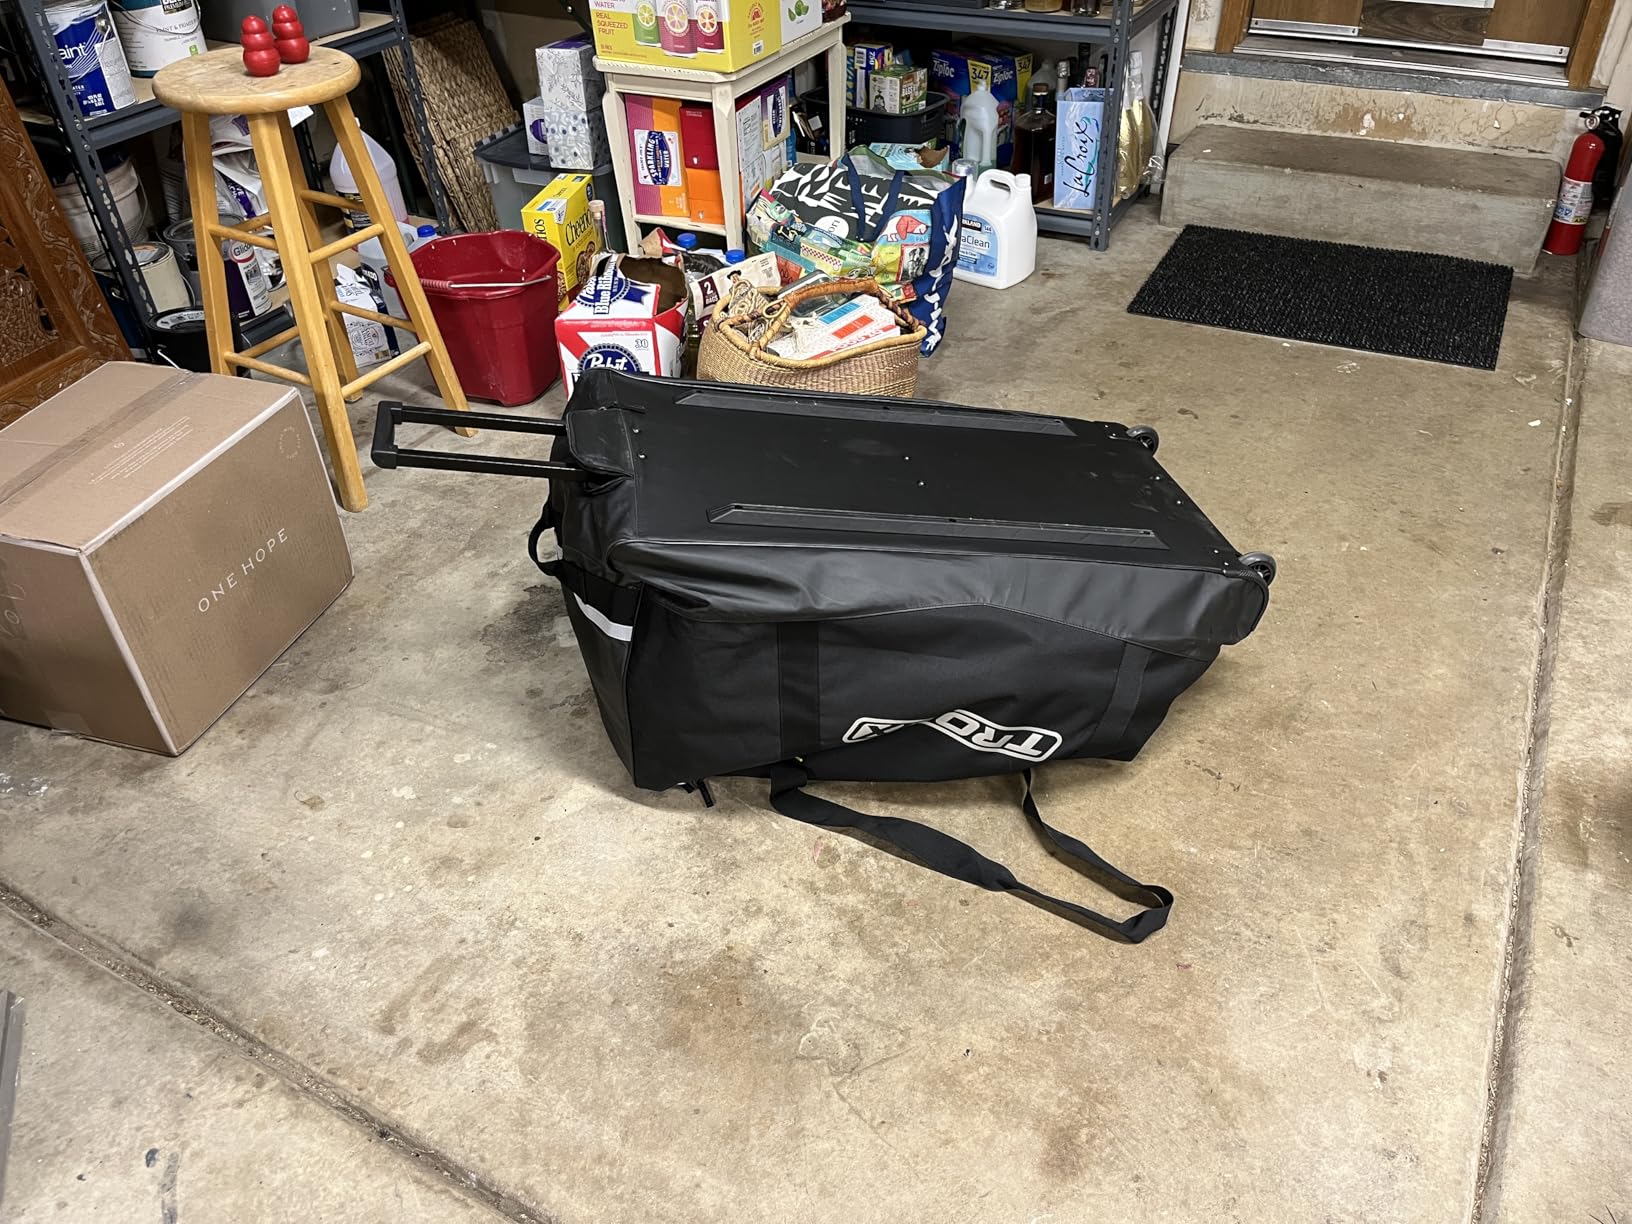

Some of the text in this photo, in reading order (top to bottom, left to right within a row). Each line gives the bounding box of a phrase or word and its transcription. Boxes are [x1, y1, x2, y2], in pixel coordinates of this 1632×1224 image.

[58, 42, 87, 60] aint
[932, 59, 955, 78] Ziploc
[970, 66, 989, 80] 347
[993, 70, 1014, 84] Ziploc
[646, 138, 660, 178] SPARKLING
[704, 281, 714, 294] 2
[594, 289, 610, 315] Blue
[635, 339, 649, 348] 30
[198, 528, 288, 613] ONE HOPE
